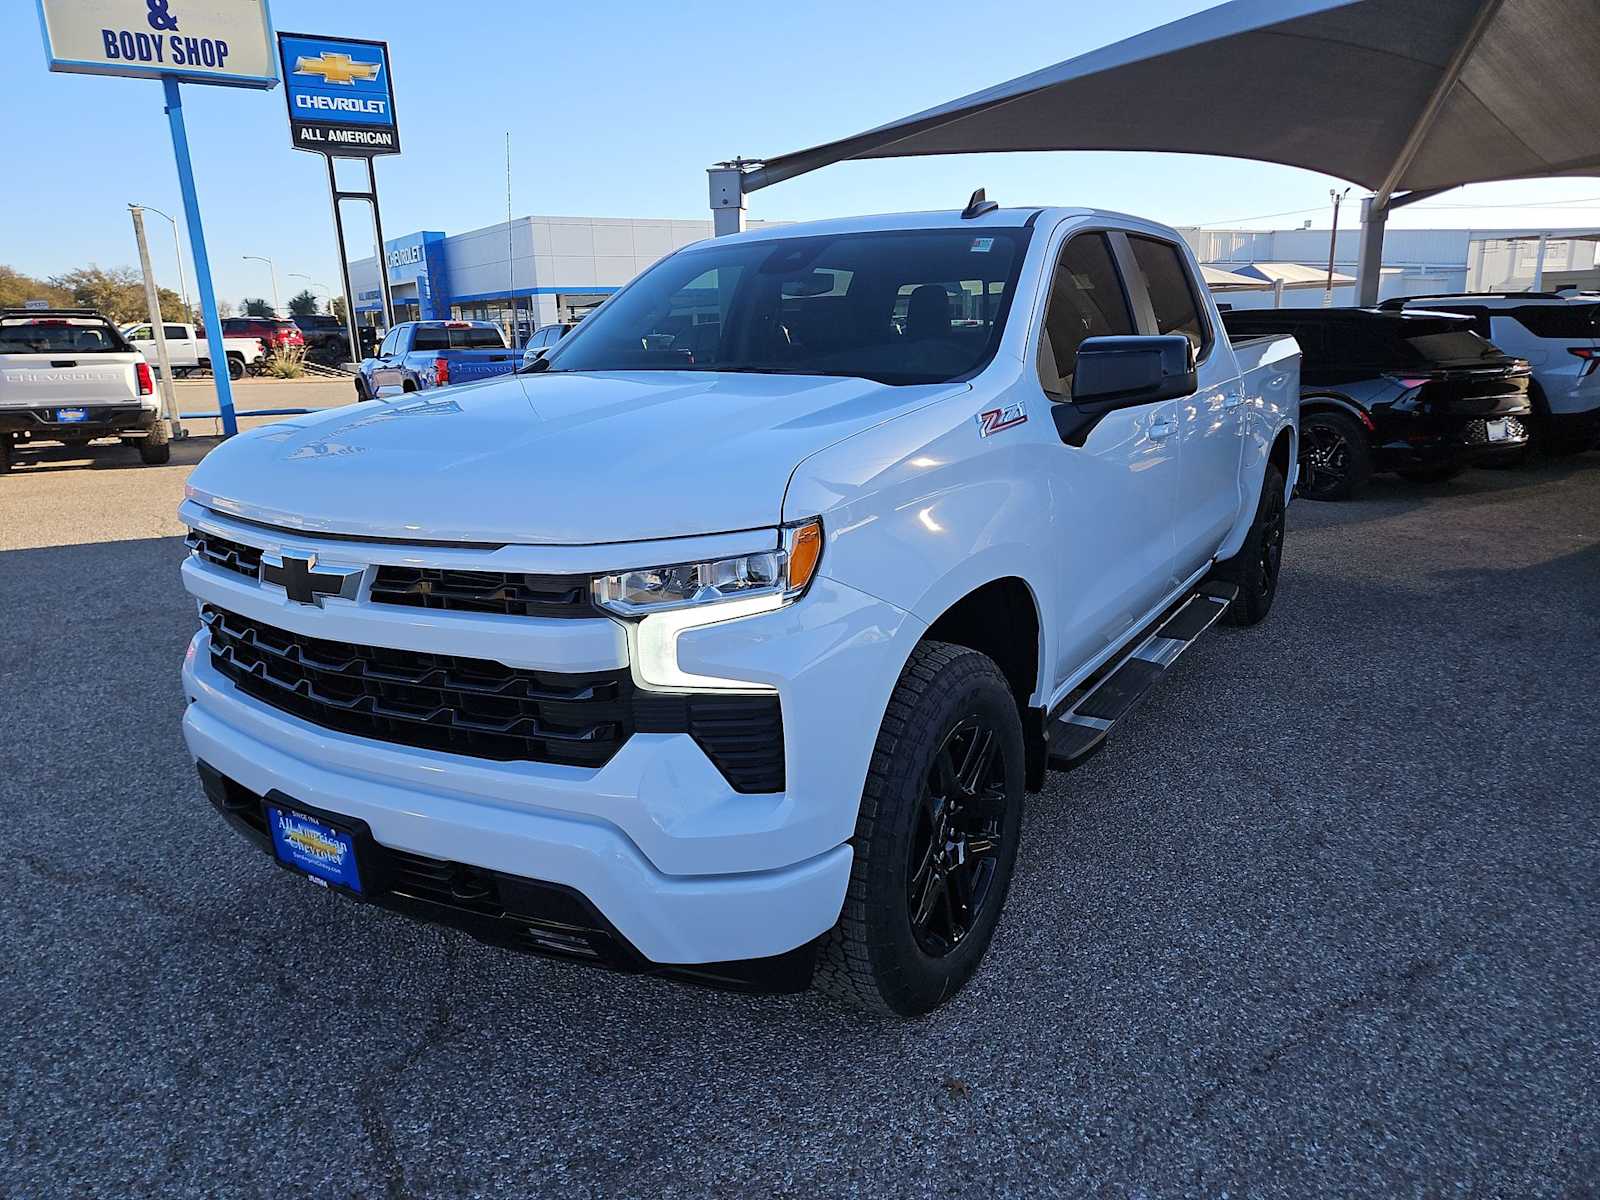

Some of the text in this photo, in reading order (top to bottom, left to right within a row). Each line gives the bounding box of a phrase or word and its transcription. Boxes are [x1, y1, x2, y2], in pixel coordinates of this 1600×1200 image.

[146, 0, 179, 31] &
[102, 29, 229, 68] BODY SHOP
[295, 94, 386, 114] CHEVROLET
[300, 127, 393, 145] ALL AMERICAN
[979, 400, 1028, 438] Z71
[278, 816, 348, 853] All American
[288, 837, 343, 865] Chevrolet
